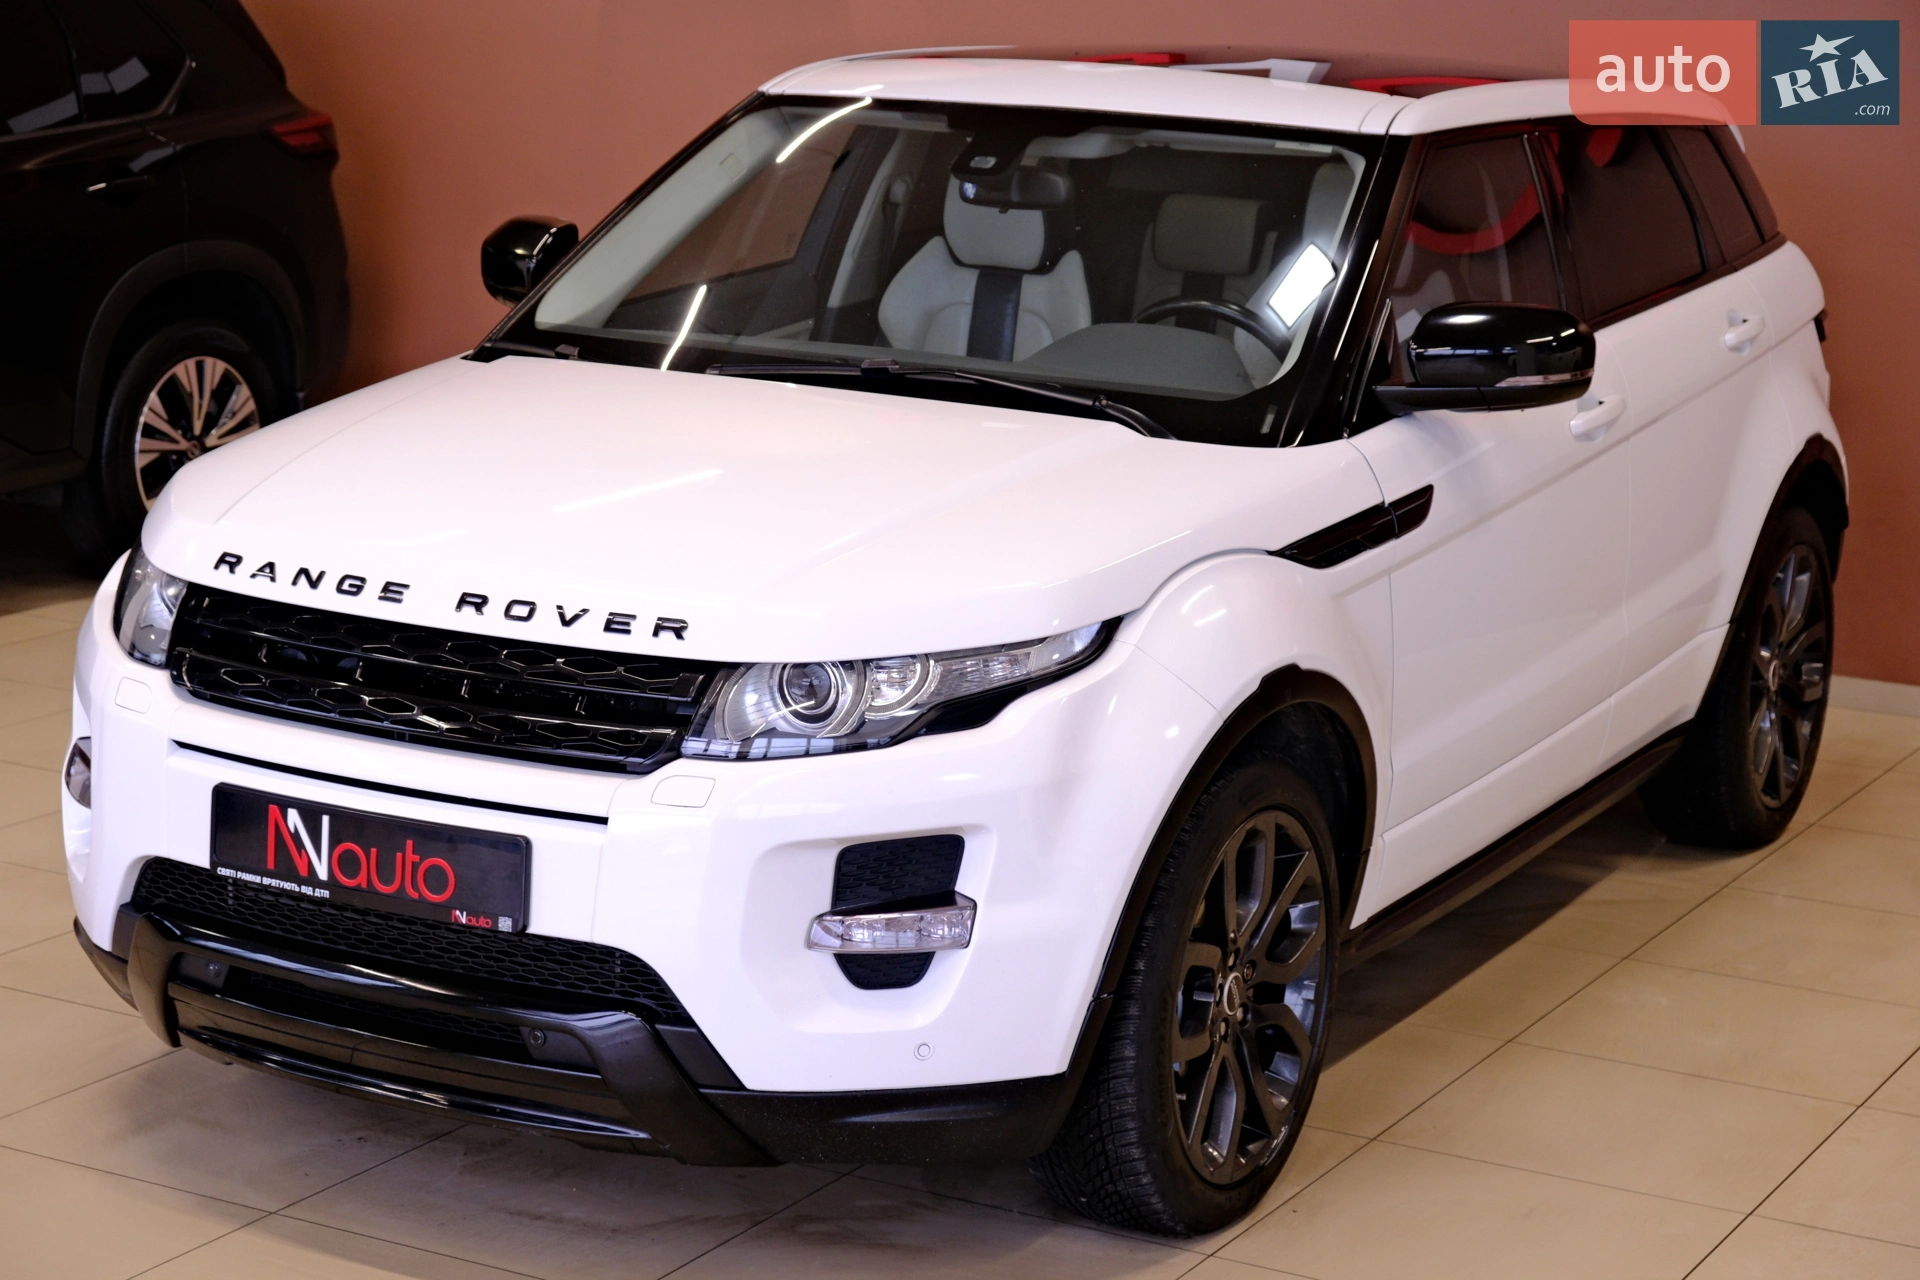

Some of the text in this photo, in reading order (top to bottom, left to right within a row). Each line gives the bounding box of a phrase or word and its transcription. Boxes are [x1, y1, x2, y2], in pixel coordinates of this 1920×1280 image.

[213, 551, 690, 641] RANGE ROVER
[217, 866, 330, 898] СВЯТІ РАМКИ ВРЯТУЮТЬ ВІД ДТП
